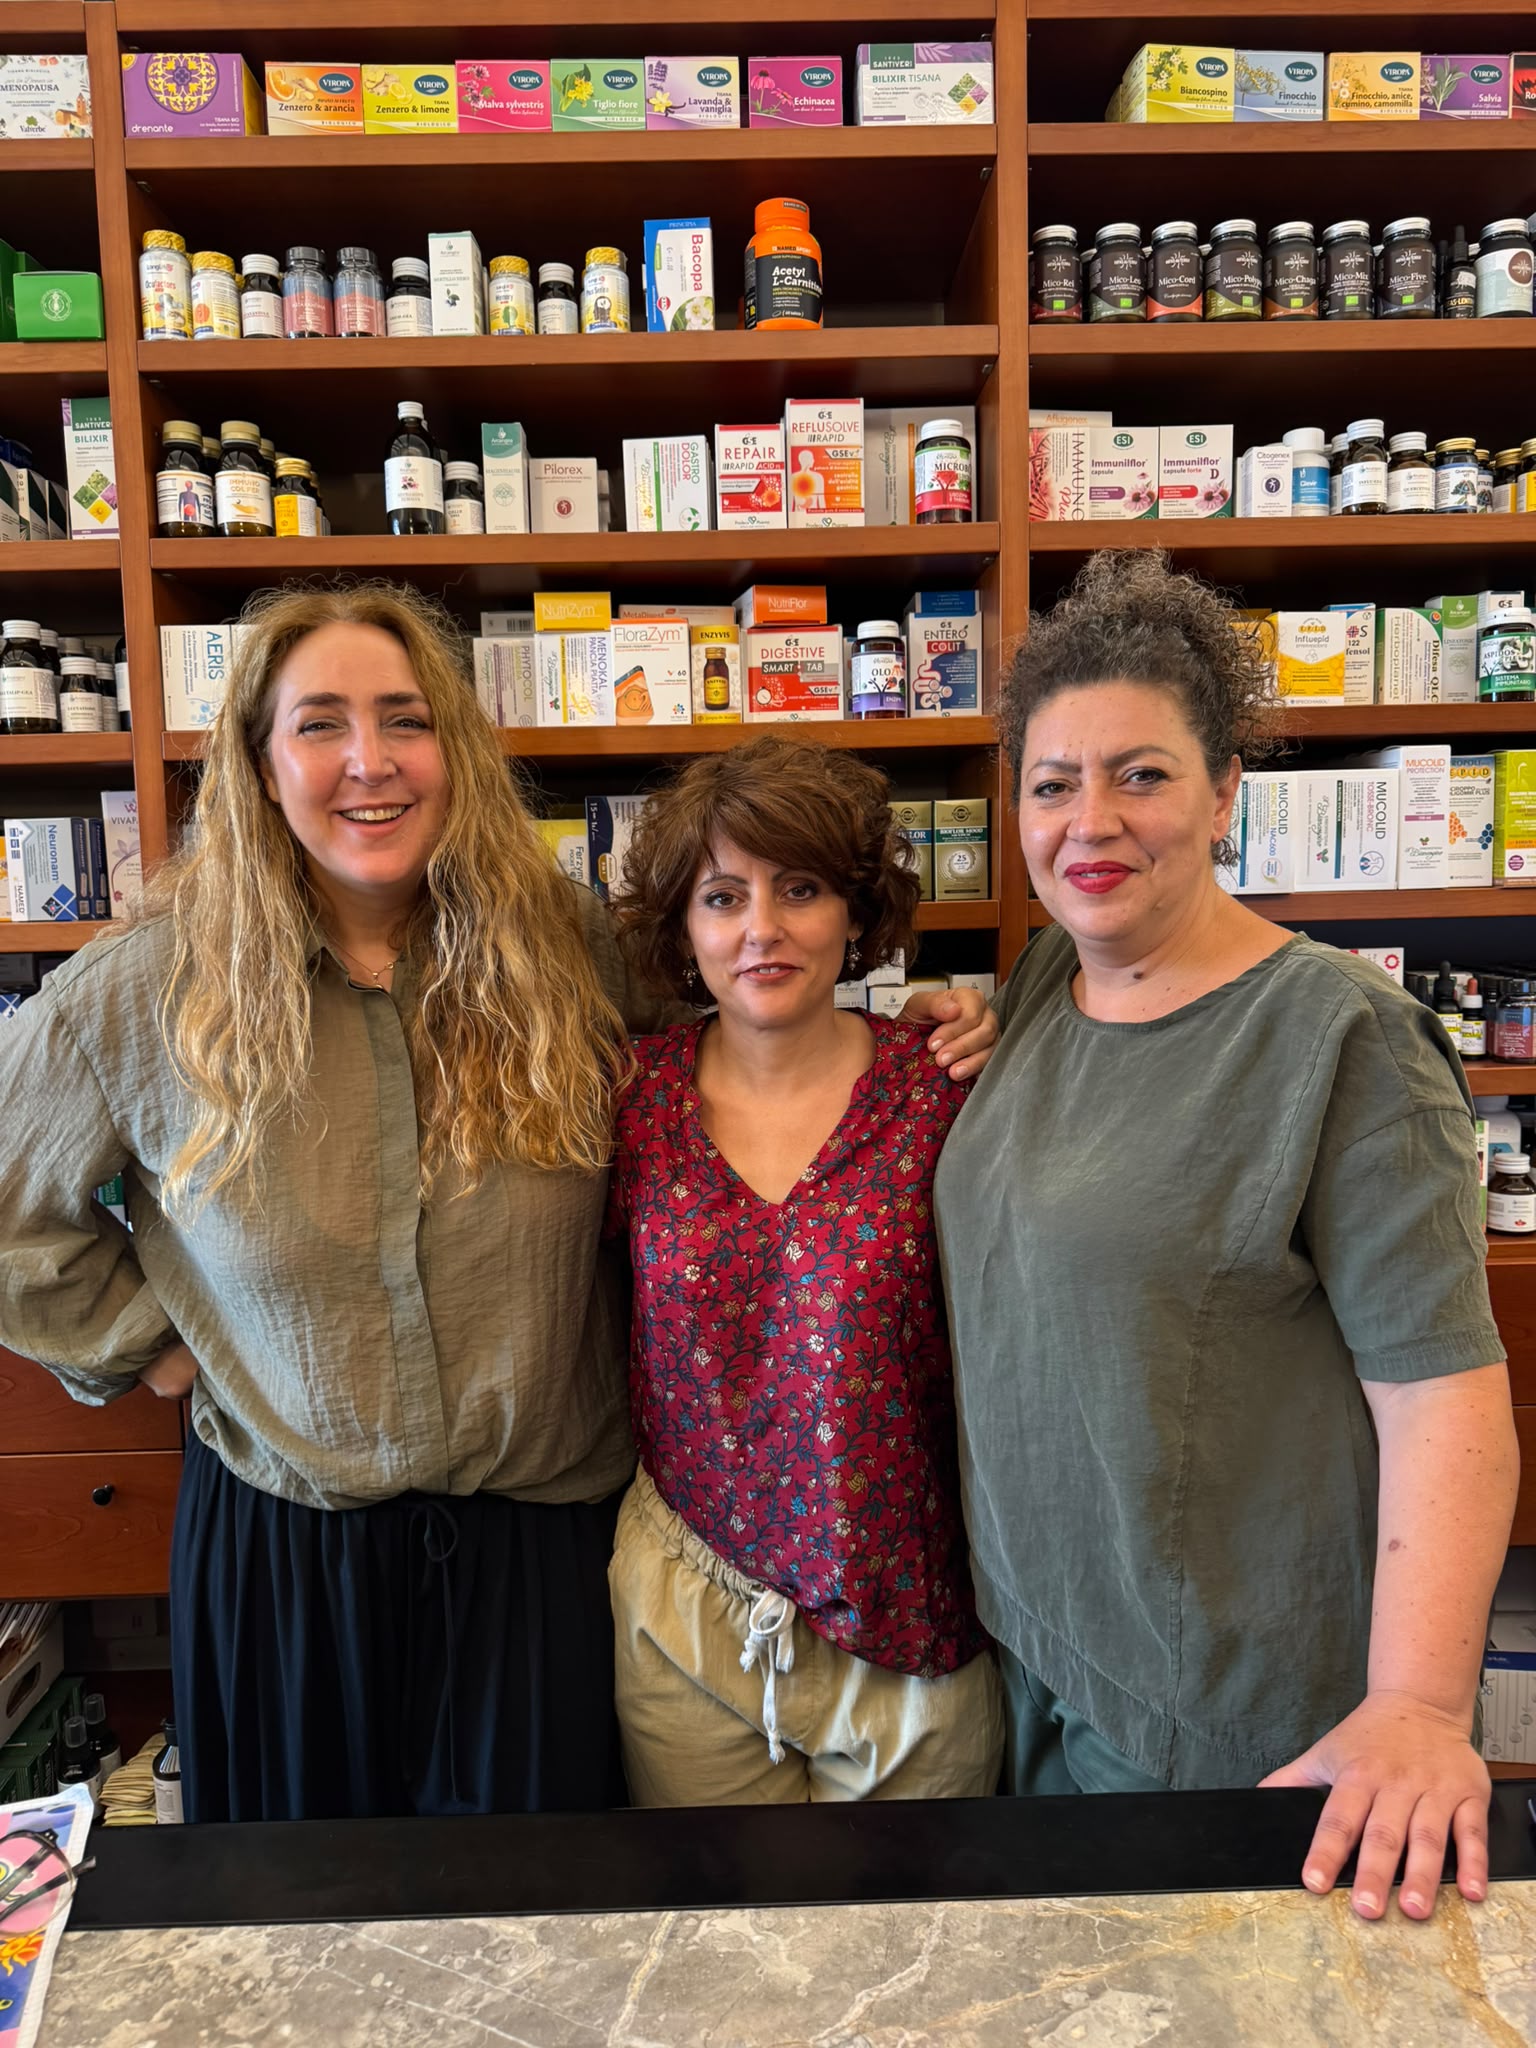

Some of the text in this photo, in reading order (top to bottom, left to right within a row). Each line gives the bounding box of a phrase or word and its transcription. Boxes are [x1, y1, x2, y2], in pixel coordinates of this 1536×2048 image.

[1199, 63, 1225, 72] VIROPA
[1288, 68, 1314, 76] VIROPA
[1384, 68, 1411, 76] VIROPA
[512, 74, 541, 84] VIROPA
[606, 75, 635, 83] VIROPA
[700, 70, 730, 80] VIROPA
[803, 72, 832, 81] VIROPA
[872, 74, 942, 83] BILIXIR TISANA
[1473, 70, 1501, 79] VIROPA
[0, 84, 60, 92] MENOPAUSA
[322, 79, 351, 88] VIROPA
[417, 80, 446, 90] VIROPA
[1180, 86, 1228, 97] Biancospino
[1279, 91, 1317, 101] Finocchio
[1351, 92, 1413, 101] Finocchio, anice,
[688, 97, 732, 106] Lavanda &
[794, 97, 835, 105] Echinacea
[1478, 93, 1502, 103] Salvia
[278, 103, 356, 113] Zenzero & arancia
[478, 99, 544, 110] Malva sylvestris
[593, 99, 639, 109] Tiglio fiore
[700, 104, 732, 114] vaniglia
[1341, 100, 1413, 109] cumino, camomilla
[375, 105, 409, 114] Zenzero
[420, 105, 450, 114] limone
[131, 124, 174, 134] drenante
[690, 234, 703, 292] Bacopa
[772, 266, 806, 278] Acetyl
[1333, 272, 1369, 282] Mico-Mix
[1389, 272, 1427, 283] Mico-Five
[75, 421, 112, 429] SANTIVER
[792, 421, 860, 433] REFLUSOLVE
[74, 434, 109, 443] BILIXIR
[816, 434, 845, 443] RAPID
[1116, 436, 1131, 445] ESI
[1188, 434, 1204, 444] ESI
[724, 447, 776, 460] REPAIR
[1256, 451, 1290, 461] Citogenex
[681, 442, 691, 481] DOLOR
[690, 442, 700, 485] GASTRO
[729, 462, 755, 470] RAPID
[1091, 459, 1146, 468] Immunilflor
[1163, 458, 1219, 467] Immunilflor
[543, 463, 583, 475] Pilorex
[1210, 468, 1220, 480] D
[1072, 432, 1085, 520] IMMUNO
[768, 597, 808, 609] NutriFlor
[541, 602, 595, 617] NutriZym
[614, 626, 681, 644] FloraZym
[700, 631, 731, 639] ENZYVIS
[924, 629, 968, 640] ENTERO
[1295, 635, 1330, 643] Influepid
[931, 642, 961, 652] COLIT
[1345, 647, 1370, 655] fensol
[206, 631, 225, 680] AERIS
[590, 637, 598, 668] PANCIA
[761, 647, 825, 659] DIGESTIVE
[597, 636, 608, 690] MENOKAL
[1392, 616, 1401, 700] Herboplanet
[763, 661, 823, 673] SMART TAB
[1430, 639, 1440, 703] Difesa QLC
[521, 645, 533, 702] PHYTOCOL
[1495, 674, 1520, 682] SISTEMA
[1405, 758, 1446, 767] MUCOLID
[1450, 759, 1480, 767] ROPOLI
[1278, 782, 1289, 835] MUCOLID
[1366, 782, 1375, 832] TOSSE-BRONC
[1375, 781, 1387, 840] MUCOLID
[1269, 810, 1277, 826] PLUS
[1269, 827, 1278, 856] NAC600
[48, 824, 59, 881] Neuronam
[575, 846, 584, 880] Ferzym
[957, 854, 967, 862] 25
[17, 885, 25, 914] NAMED
